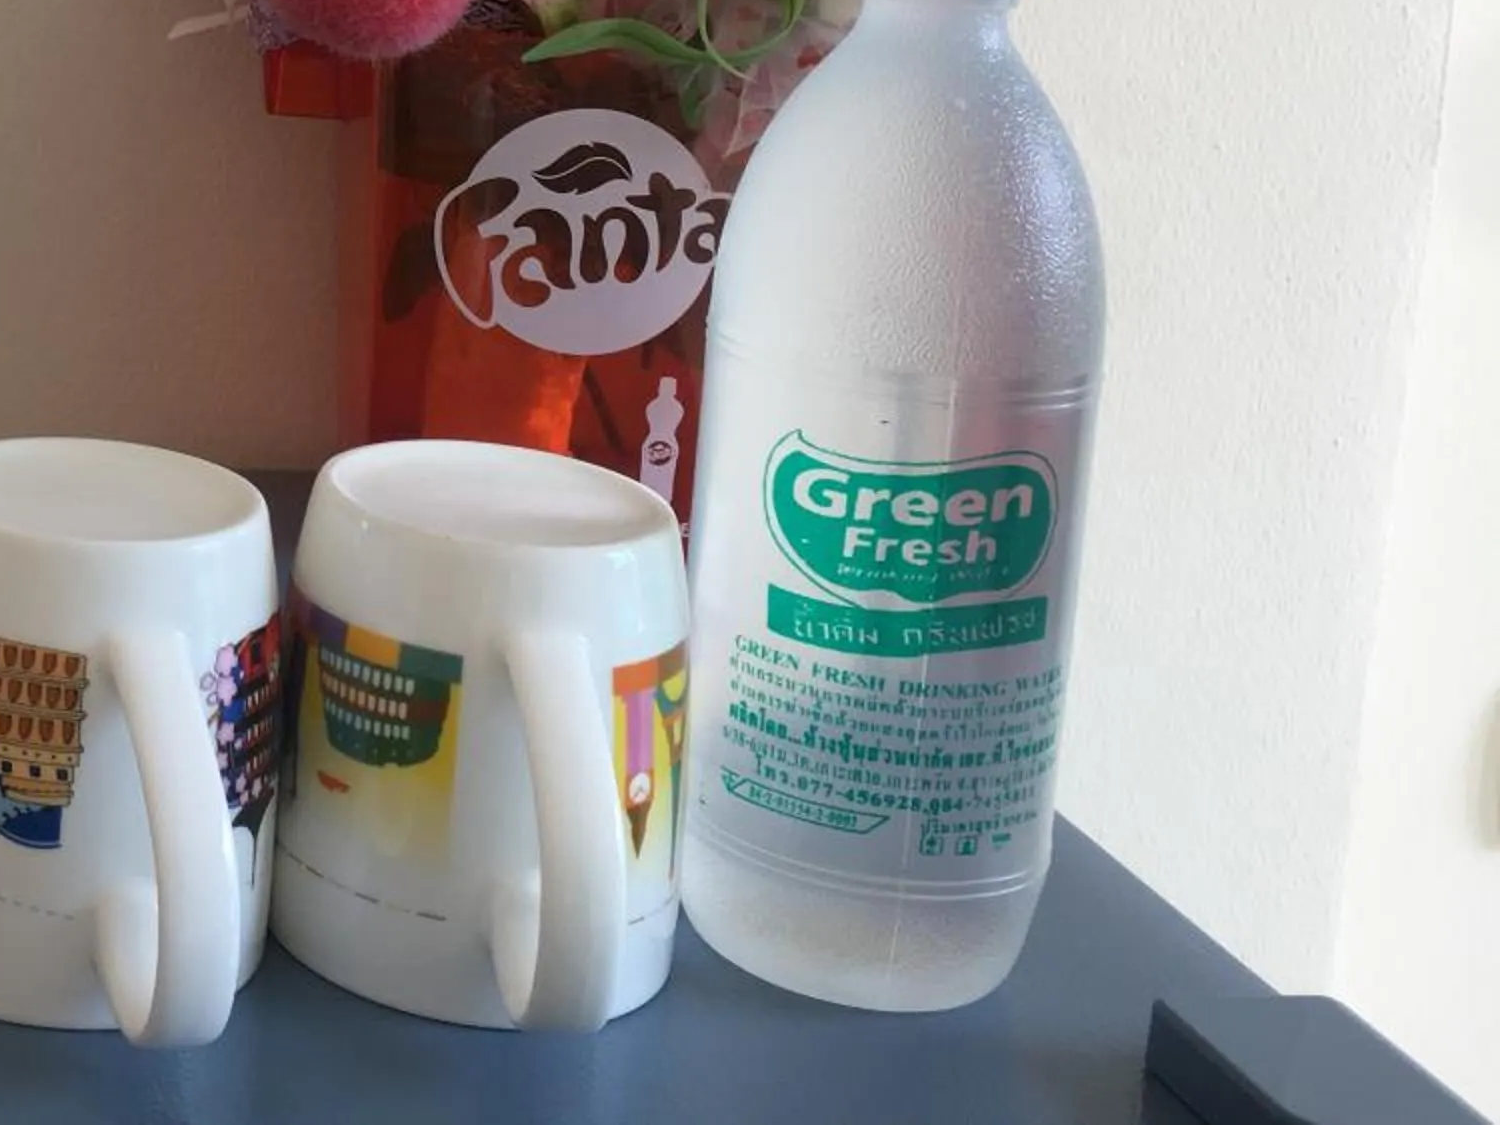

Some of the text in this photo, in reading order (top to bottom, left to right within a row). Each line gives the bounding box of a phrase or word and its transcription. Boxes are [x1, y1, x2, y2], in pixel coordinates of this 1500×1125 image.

[438, 171, 732, 324] Fanta
[792, 467, 1034, 527] Green
[842, 526, 997, 566] Fresh
[734, 634, 800, 671] GREEN
[811, 661, 887, 692] FRESH
[899, 679, 1008, 700] DRINKING
